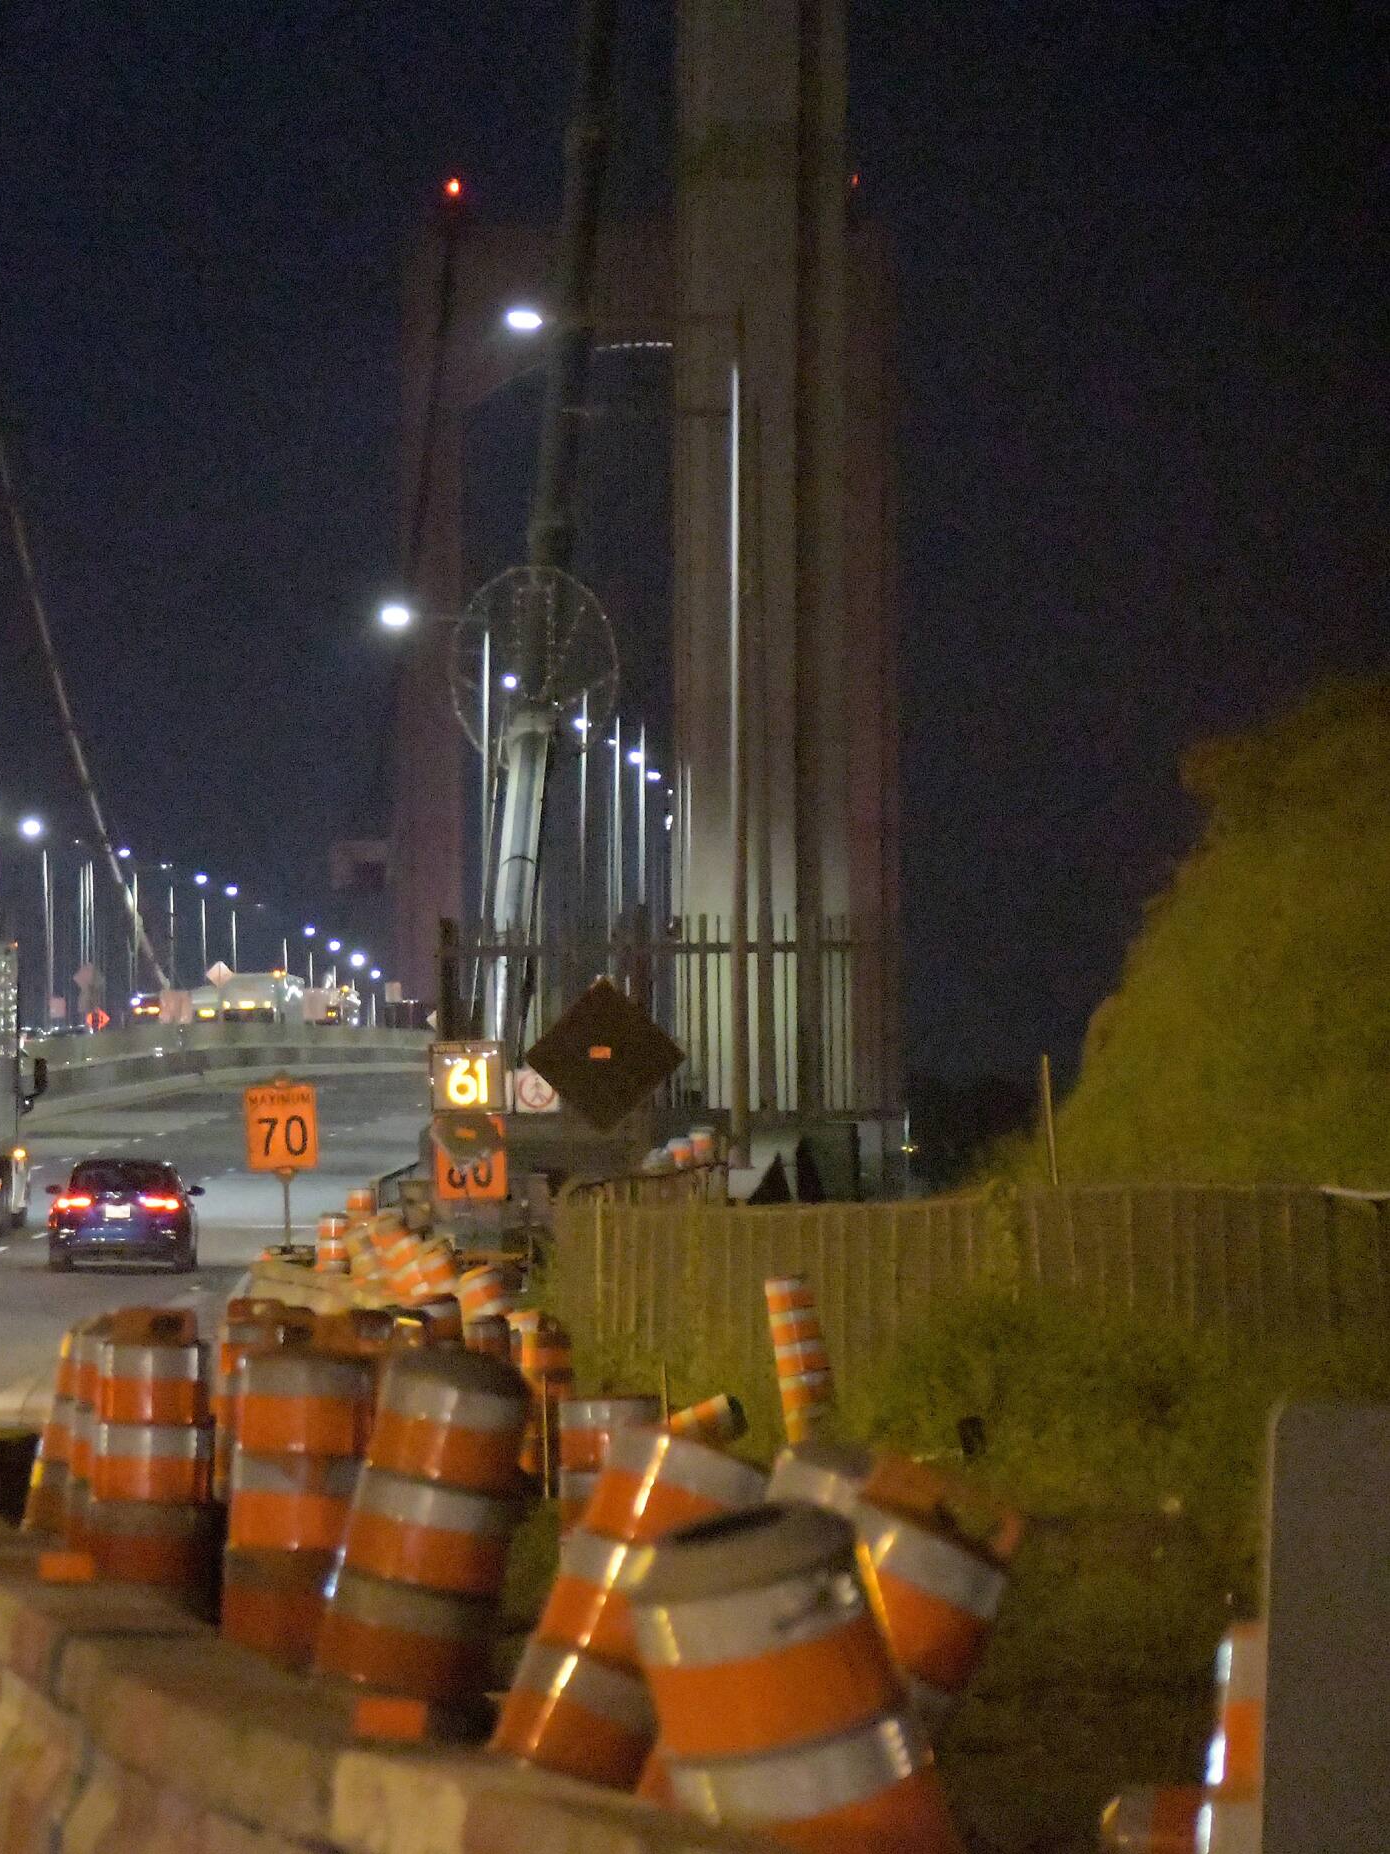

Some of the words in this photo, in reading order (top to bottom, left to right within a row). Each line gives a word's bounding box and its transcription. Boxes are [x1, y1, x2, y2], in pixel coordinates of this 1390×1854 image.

[248, 1093, 311, 1105] MAXIMUM
[448, 1058, 489, 1105] 61
[258, 1115, 308, 1157] 70
